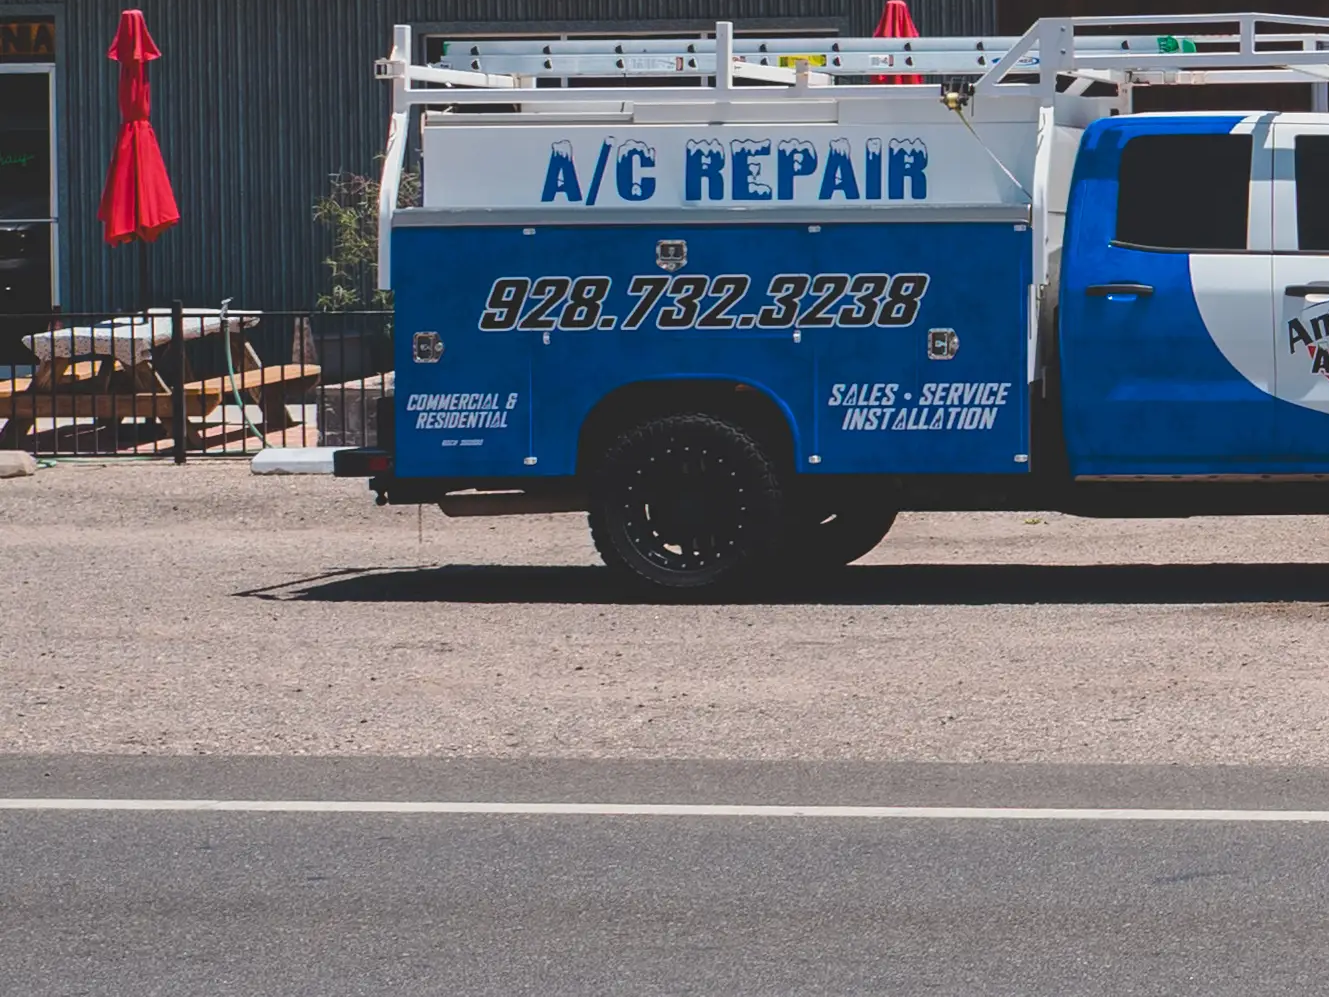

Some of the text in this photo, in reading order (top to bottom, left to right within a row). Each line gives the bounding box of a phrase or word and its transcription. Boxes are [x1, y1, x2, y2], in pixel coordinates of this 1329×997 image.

[540, 135, 929, 205] A/C REPAIR
[478, 272, 930, 331] 928.732.3238
[406, 392, 518, 411] COMMERCIAL &
[828, 382, 1012, 406] SALES SERVICE
[415, 411, 508, 429] RESIDENTIAL
[841, 407, 999, 430] INSTALLATION
